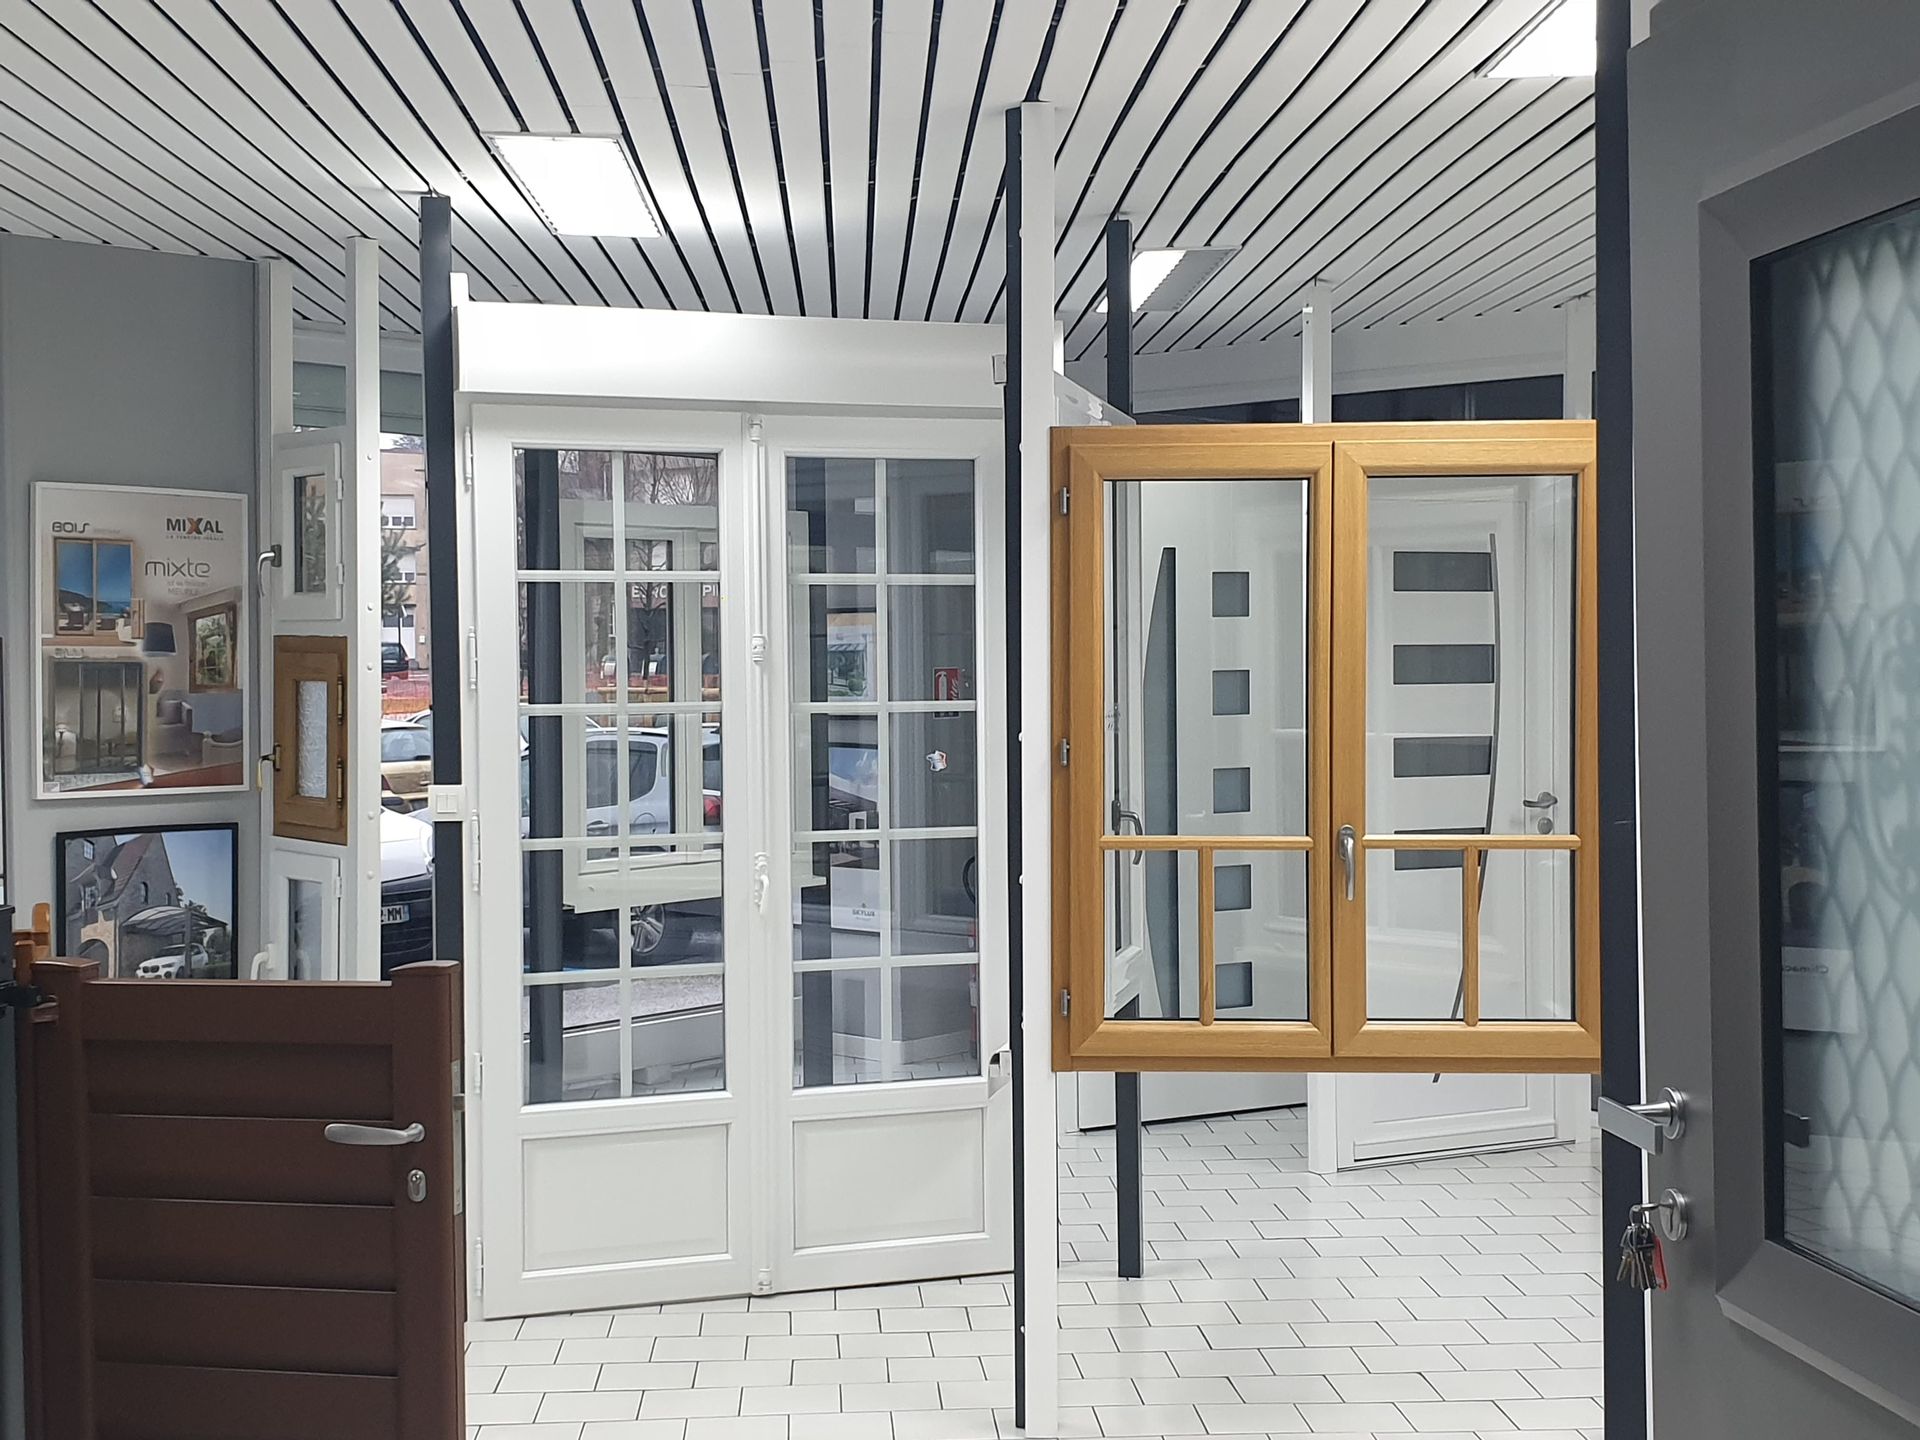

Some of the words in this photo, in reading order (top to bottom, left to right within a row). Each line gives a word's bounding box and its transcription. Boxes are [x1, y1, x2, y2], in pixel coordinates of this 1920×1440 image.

[52, 521, 90, 534] BOIS
[166, 517, 224, 535] MIXAL
[145, 557, 211, 578] mixte
[631, 585, 668, 599] ERO
